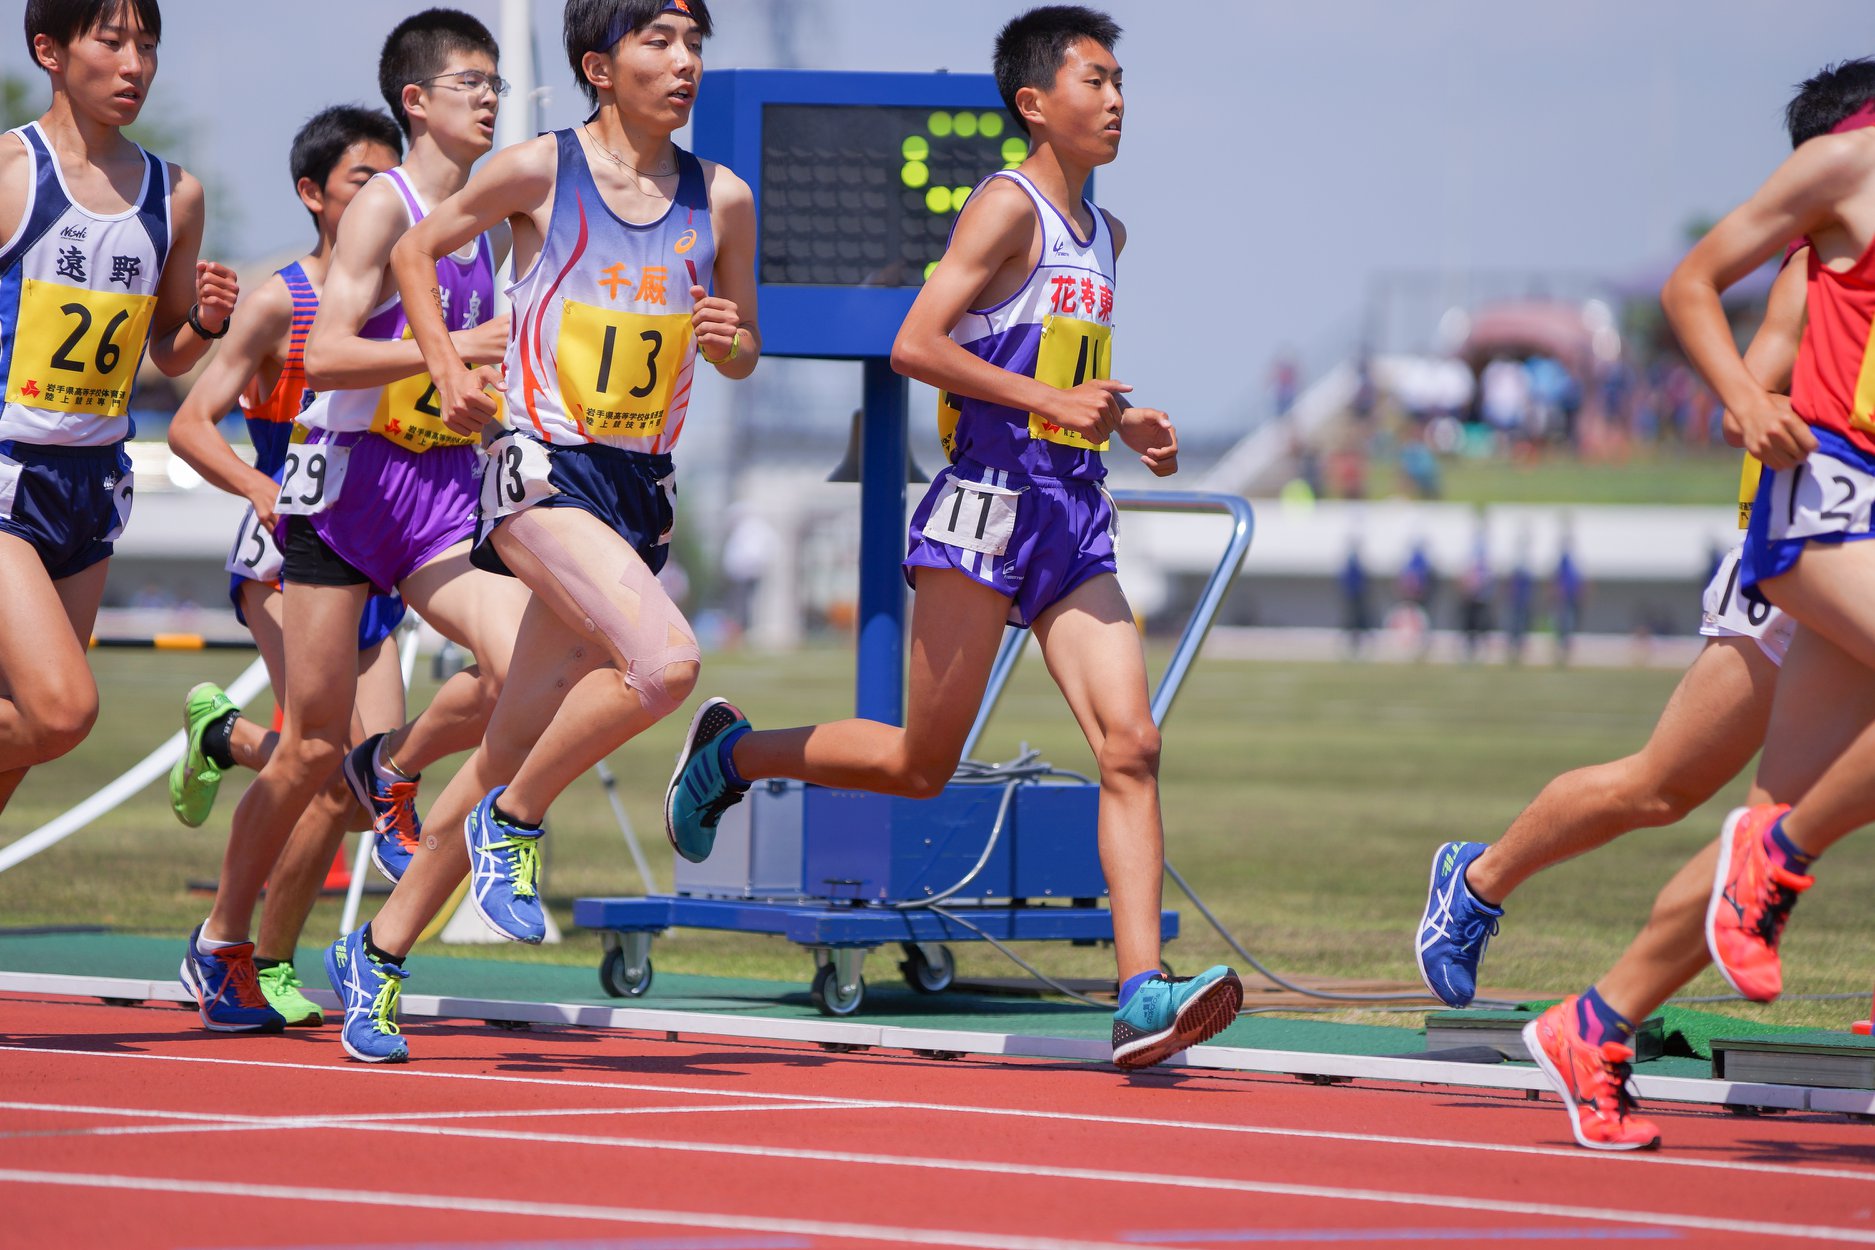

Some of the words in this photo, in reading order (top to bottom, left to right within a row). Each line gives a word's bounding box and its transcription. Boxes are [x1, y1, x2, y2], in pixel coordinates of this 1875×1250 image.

[56, 245, 141, 289] 遠野
[597, 262, 668, 305] 千厩
[1051, 276, 1113, 322] 花巻東
[50, 302, 129, 375] 26
[596, 325, 662, 398] 13
[278, 453, 327, 504] 29
[496, 445, 525, 508] 13
[1789, 463, 1855, 526] 12
[948, 487, 994, 540] 11
